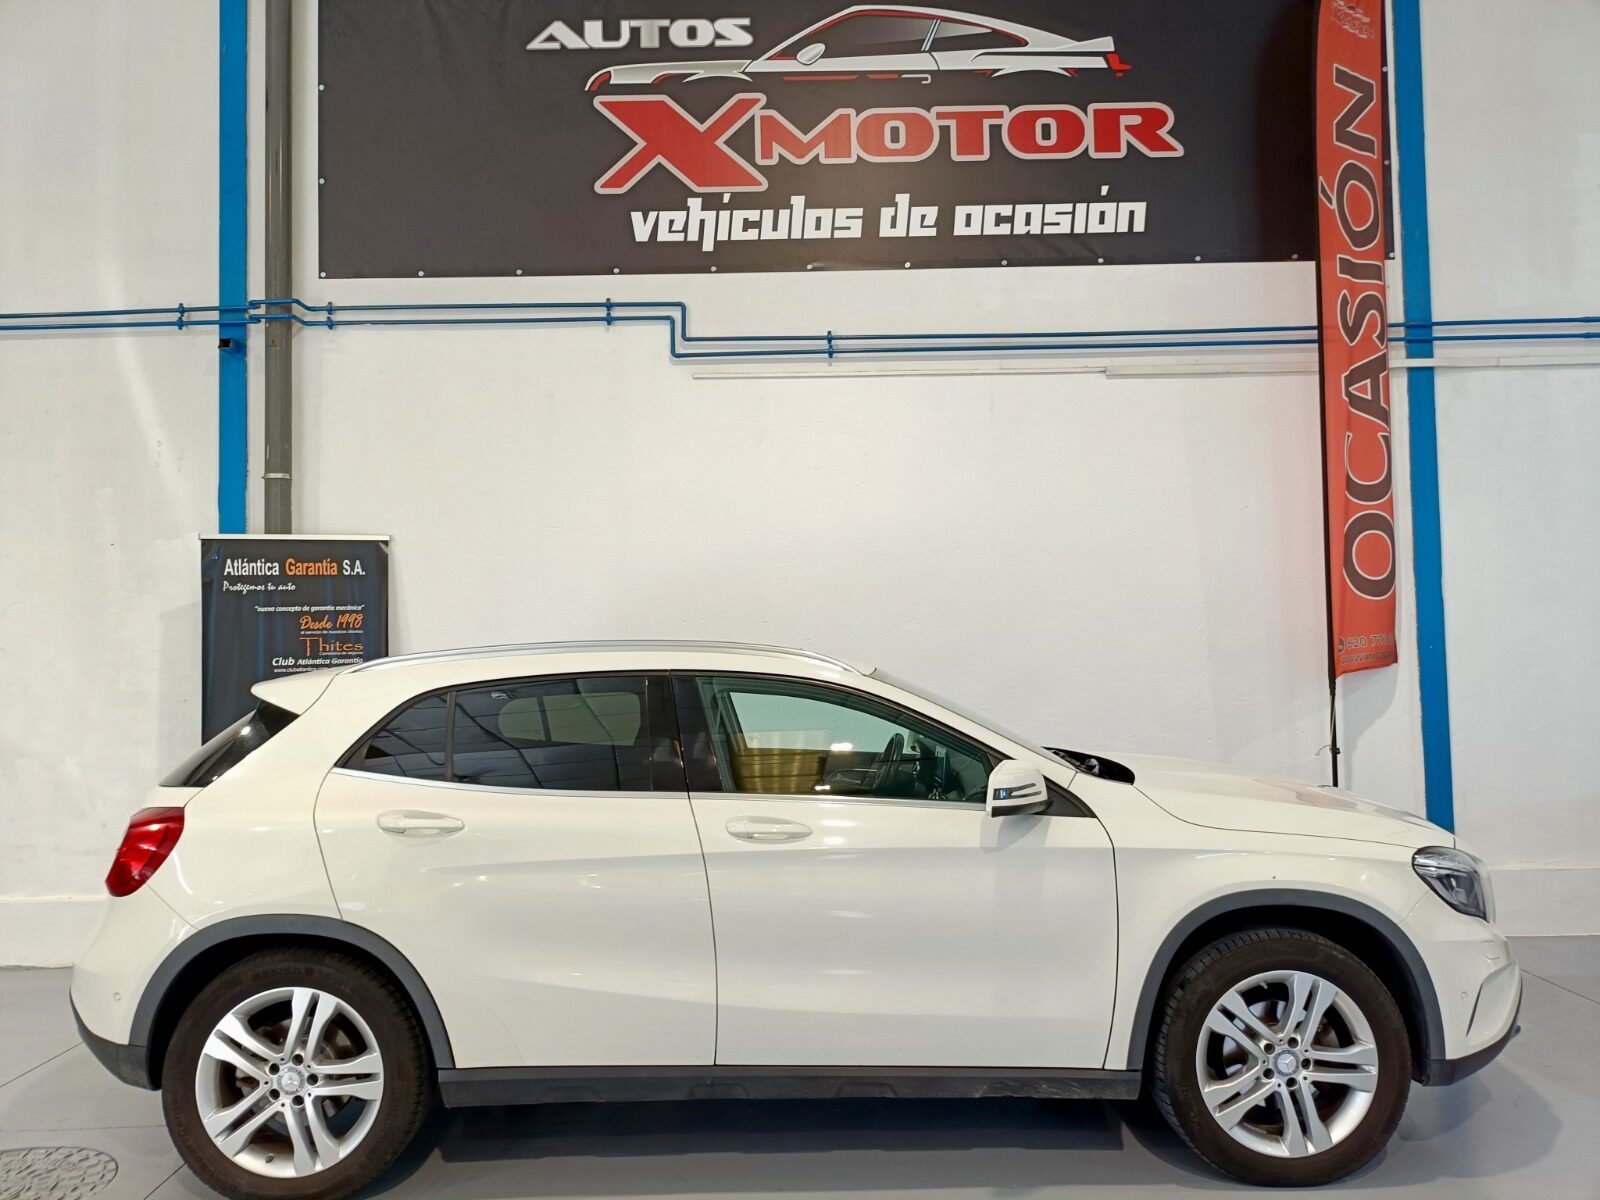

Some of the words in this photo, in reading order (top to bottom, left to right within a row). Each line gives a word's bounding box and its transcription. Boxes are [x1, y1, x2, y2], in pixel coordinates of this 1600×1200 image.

[525, 17, 754, 51] AUTOS
[630, 193, 863, 252] vehículos
[878, 194, 938, 237] de
[953, 185, 1147, 236] ocasión
[1318, 64, 1397, 601] OCASIÓN
[224, 558, 279, 576] Atlántica
[285, 557, 338, 576] Garantía
[342, 560, 366, 576] S.A.
[223, 580, 265, 595] Protegemos
[267, 582, 276, 591] tu
[277, 582, 296, 591] auto
[276, 605, 302, 613] concepto
[299, 614, 333, 630] Desde
[336, 613, 364, 629] 1998
[299, 637, 364, 657] Thites
[272, 656, 295, 666] Club
